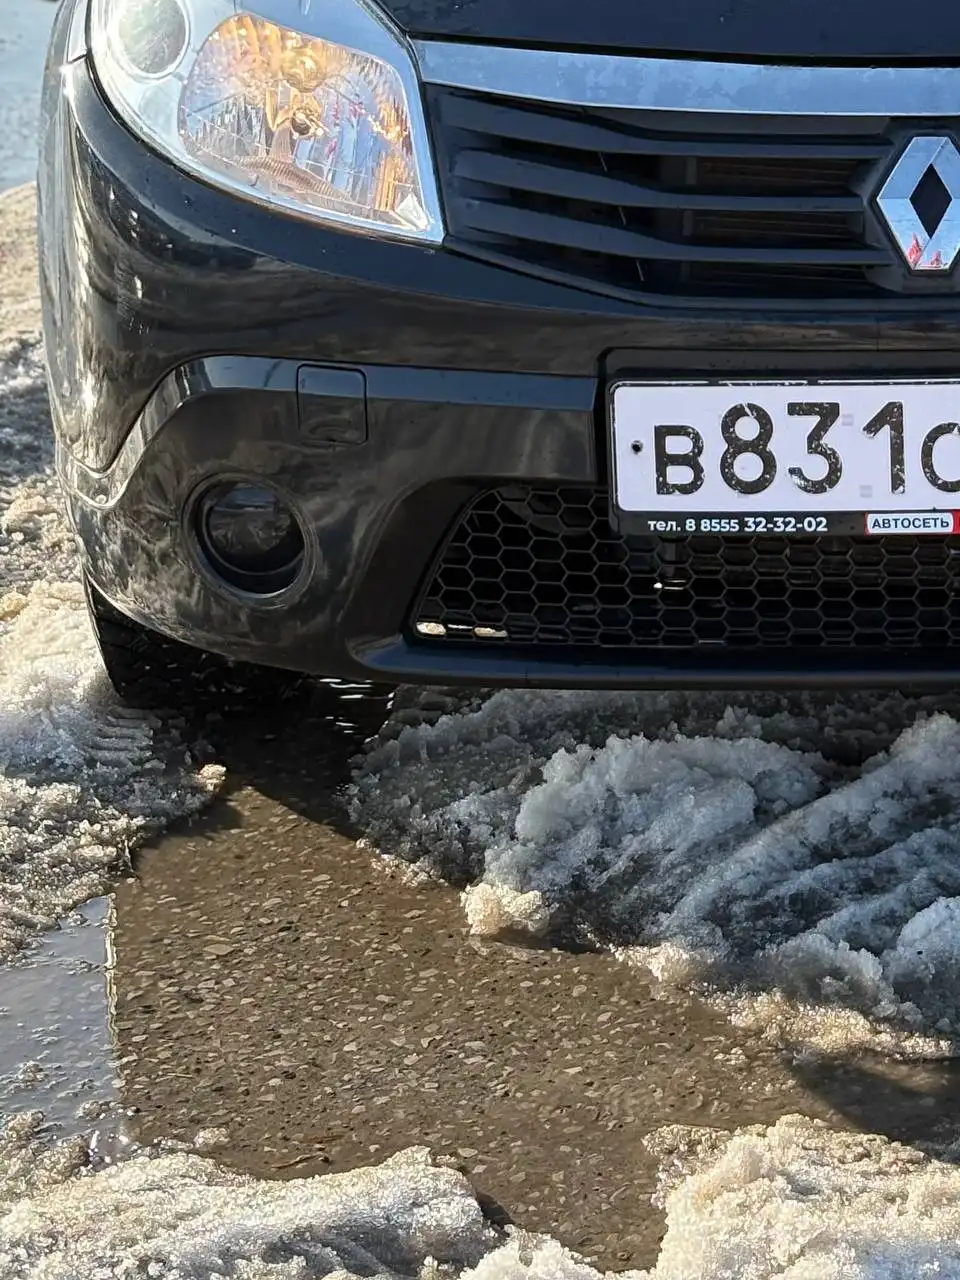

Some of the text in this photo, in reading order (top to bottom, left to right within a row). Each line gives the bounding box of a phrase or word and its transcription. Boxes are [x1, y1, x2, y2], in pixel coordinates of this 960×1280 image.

[647, 516, 829, 532] тел. 8 8555 32-32-02
[871, 517, 950, 529] АВТОСЕТЬ
